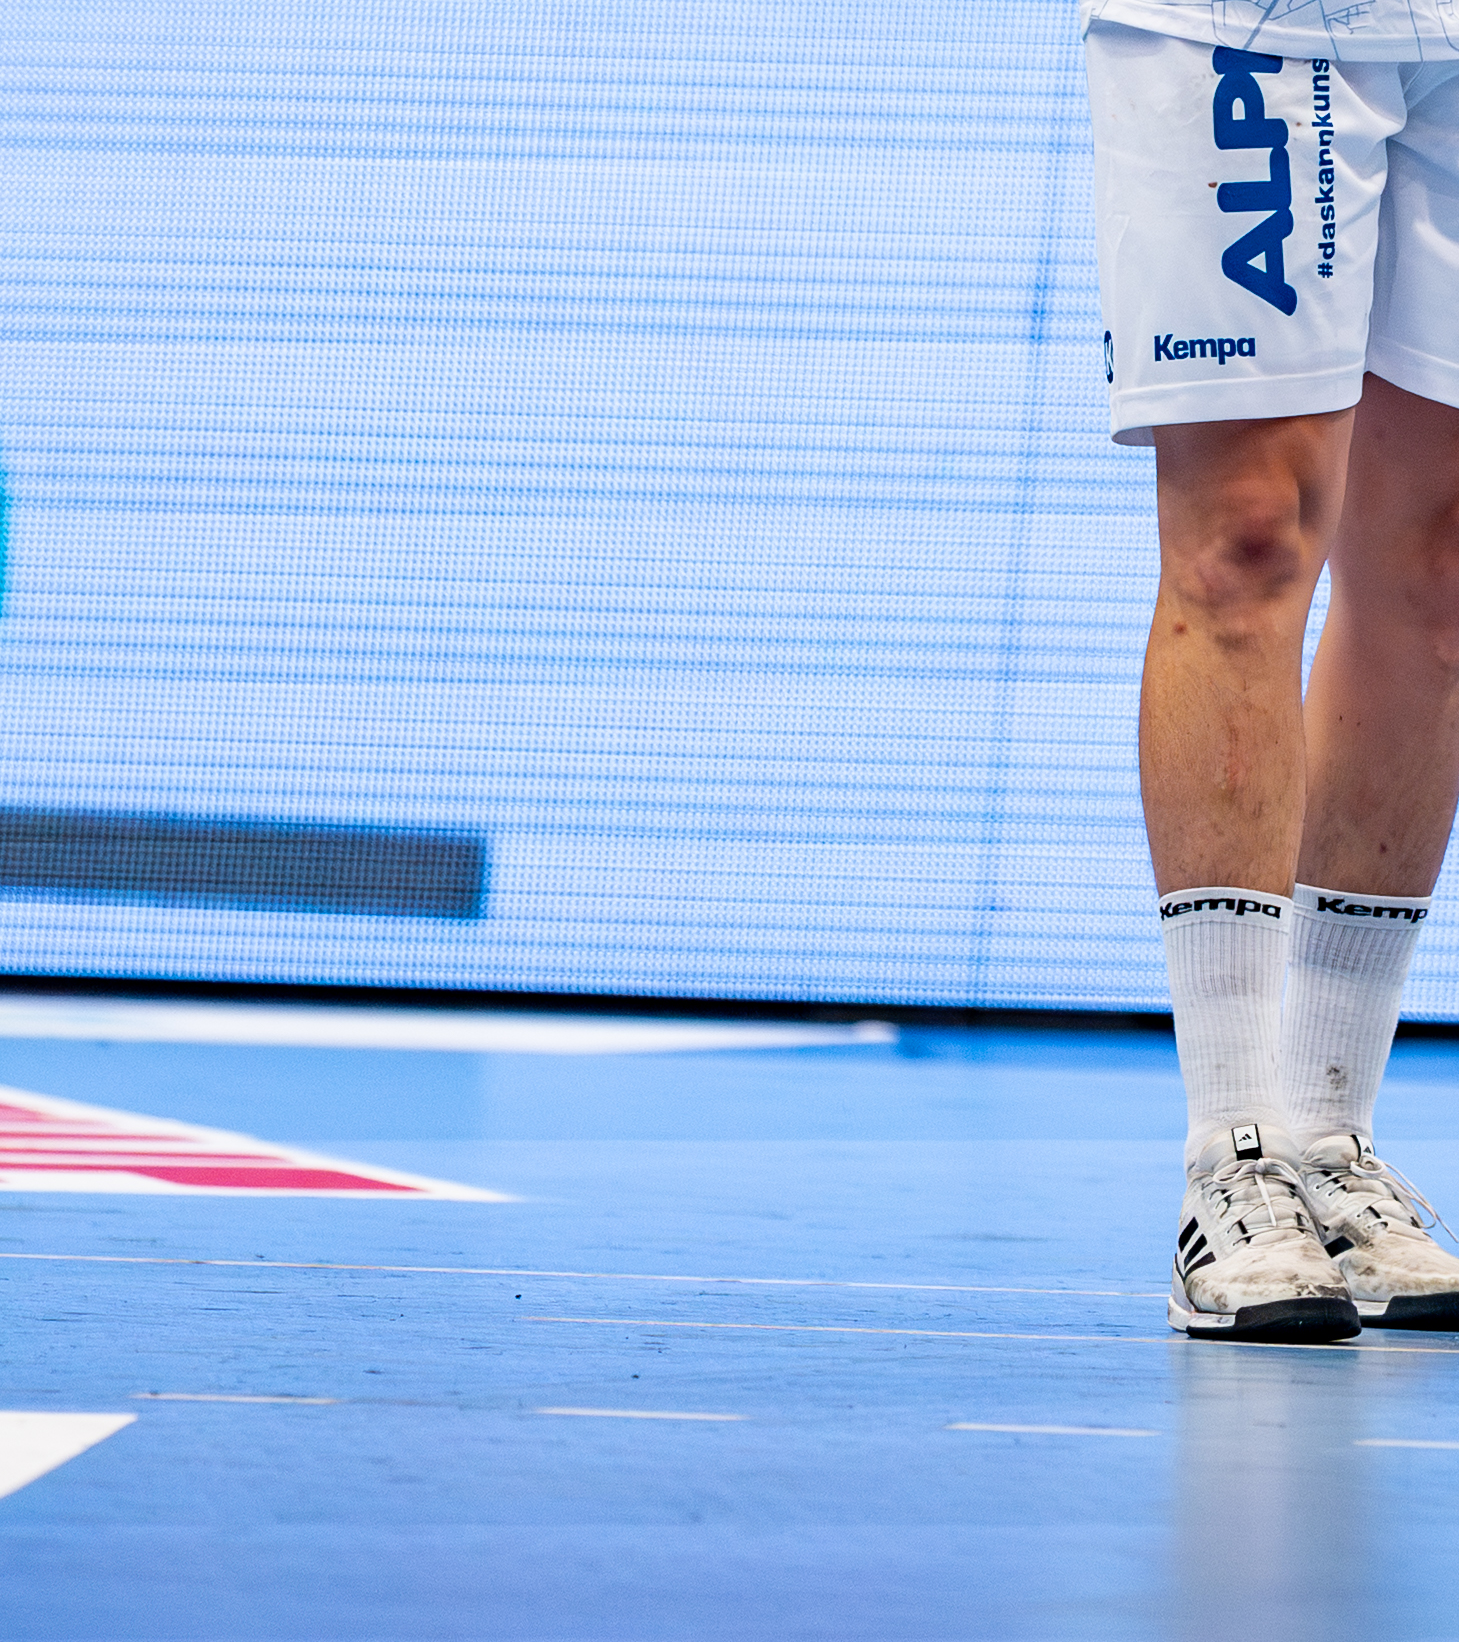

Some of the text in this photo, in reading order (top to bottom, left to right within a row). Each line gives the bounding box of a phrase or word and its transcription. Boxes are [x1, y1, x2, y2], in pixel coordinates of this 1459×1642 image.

[1311, 58, 1336, 279] #daskannkuns
[1153, 333, 1257, 366] Kempa
[1159, 897, 1282, 921] Kempa
[1317, 896, 1428, 925] Kemp
